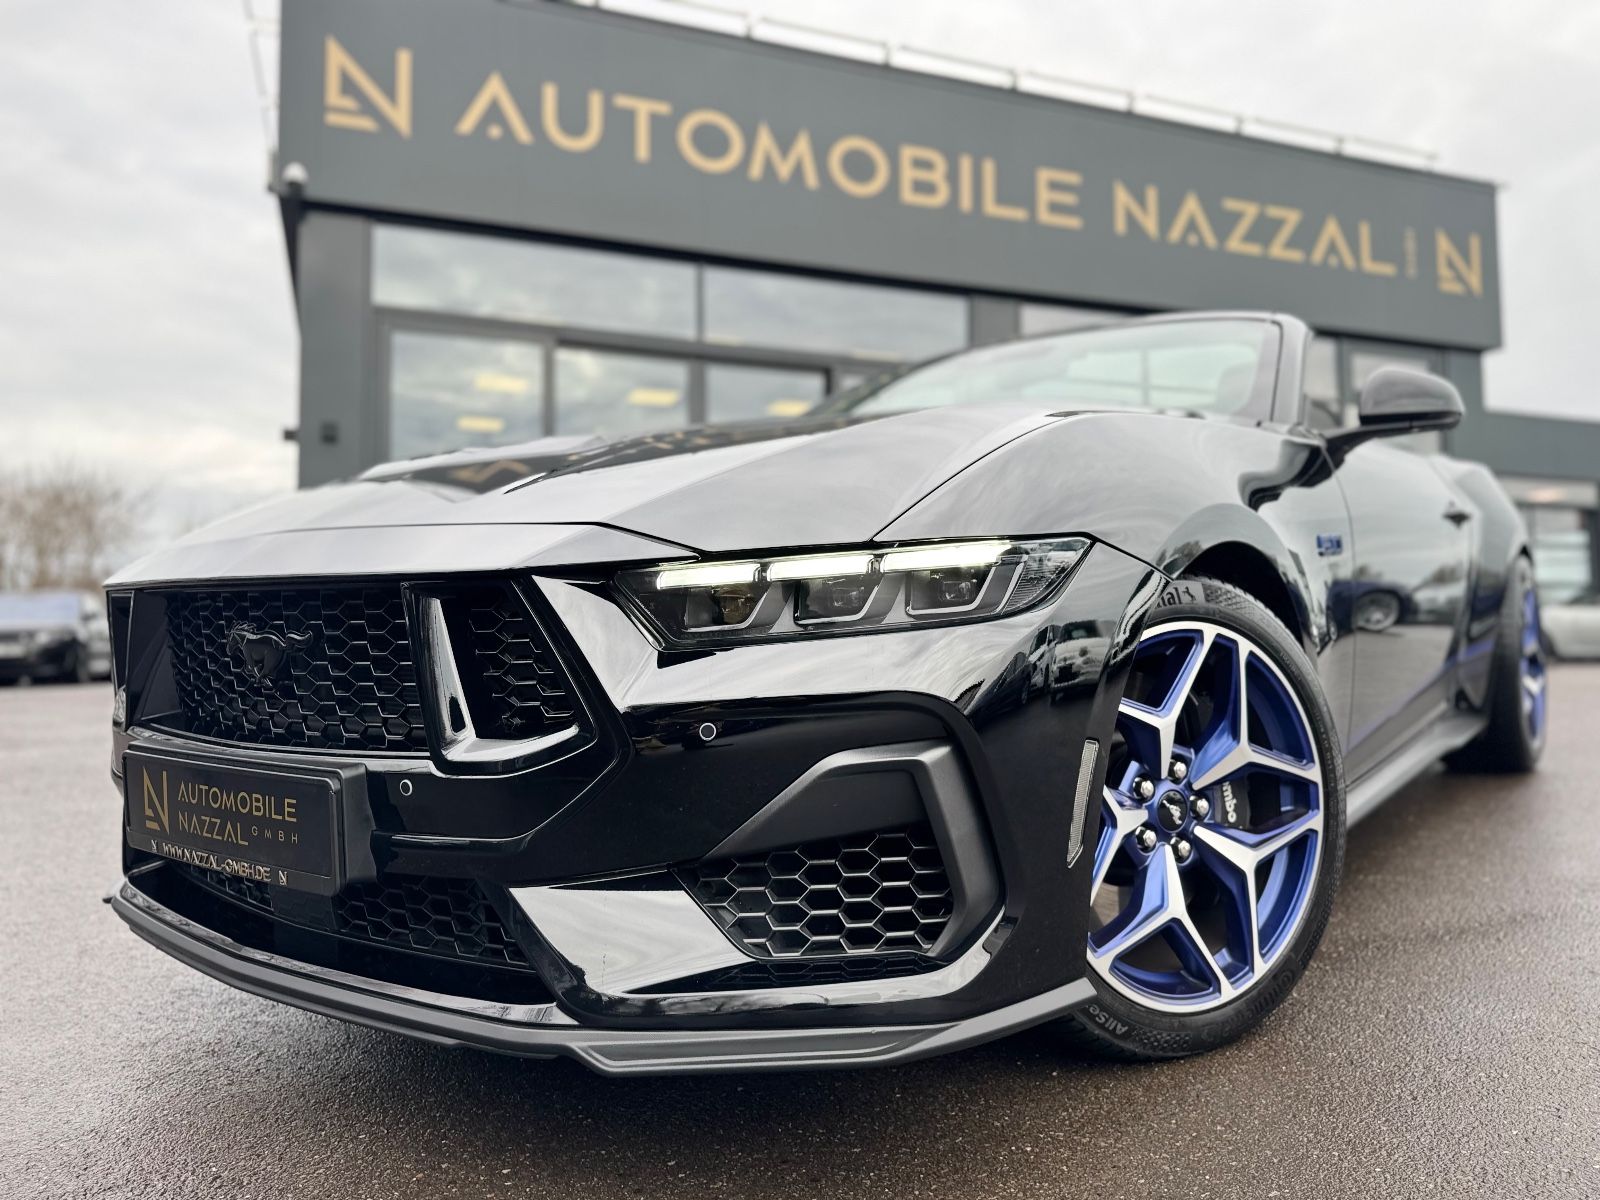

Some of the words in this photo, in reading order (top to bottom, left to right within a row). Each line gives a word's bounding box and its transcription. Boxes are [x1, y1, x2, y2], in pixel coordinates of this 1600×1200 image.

[454, 72, 1084, 230] AUTOMOBILE
[1112, 179, 1398, 278] NAZZAL
[177, 780, 297, 823] AUTOMOBILE
[178, 810, 249, 846] NAZZAL
